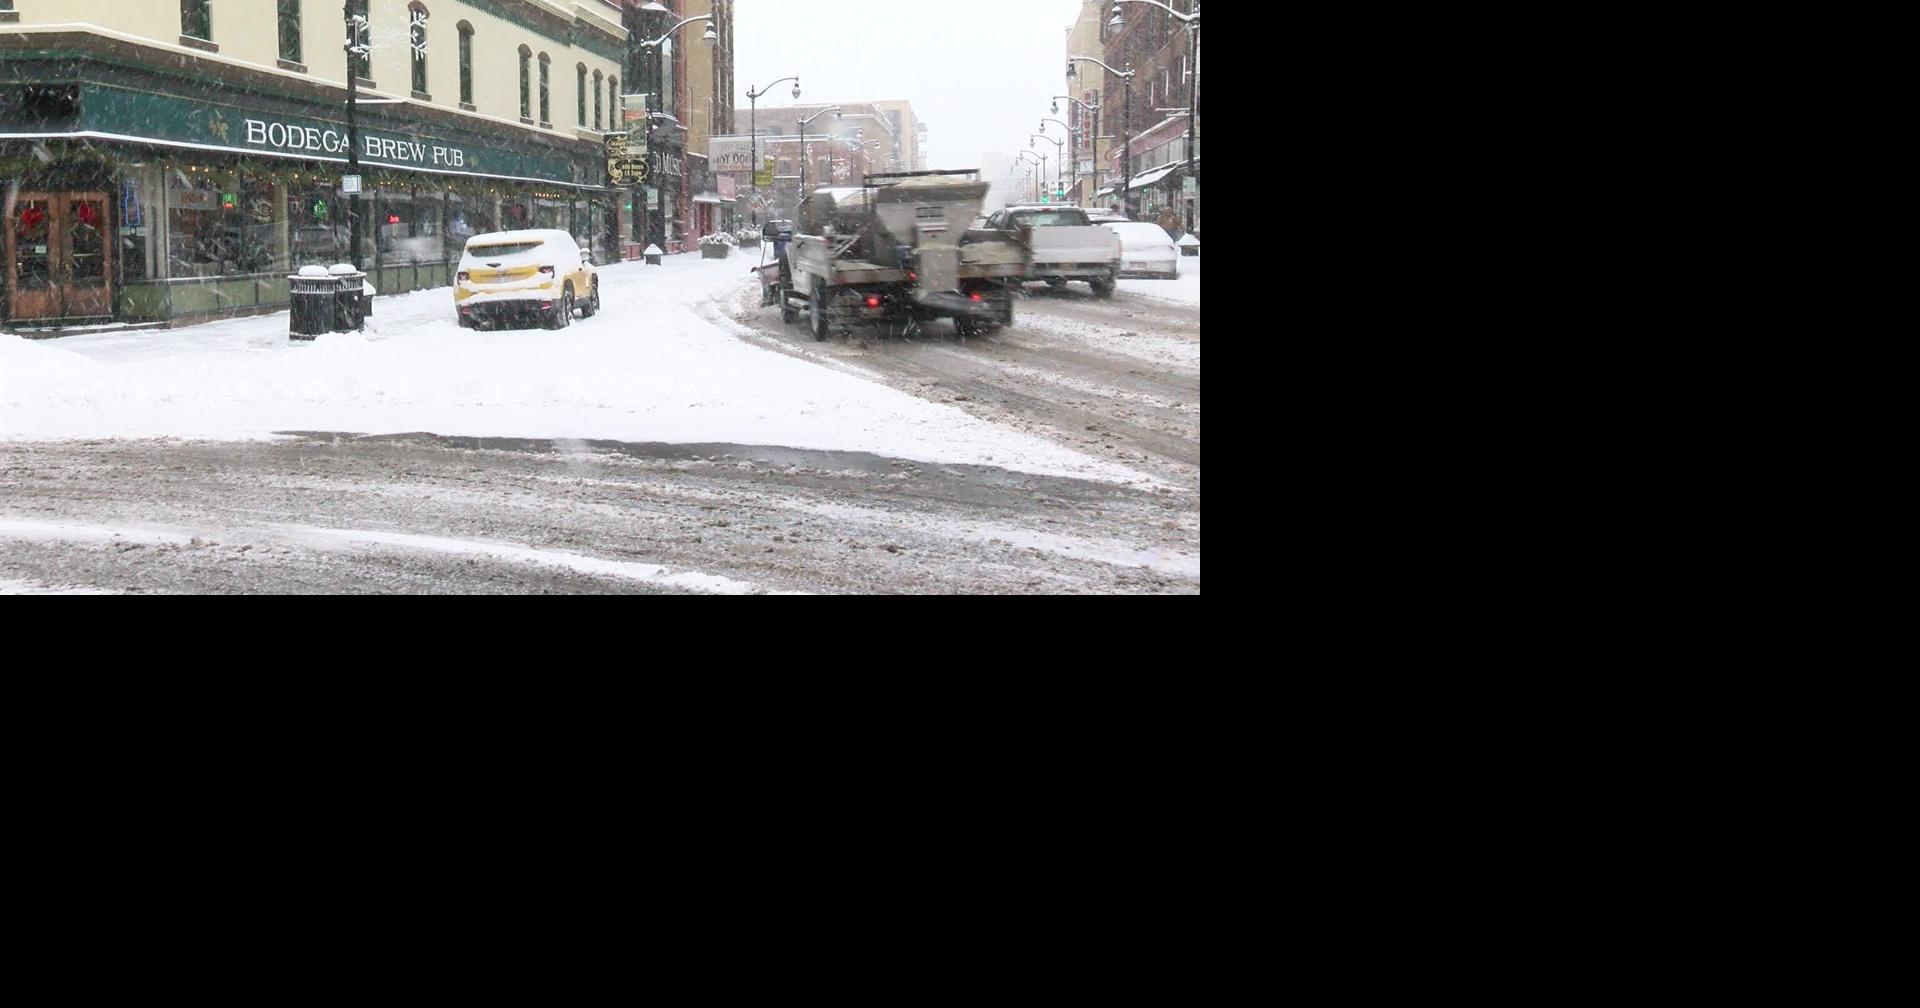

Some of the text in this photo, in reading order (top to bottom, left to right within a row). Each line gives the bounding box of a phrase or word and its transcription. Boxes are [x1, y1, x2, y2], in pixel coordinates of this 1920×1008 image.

[245, 119, 464, 168] BODEGA BREW PUB
